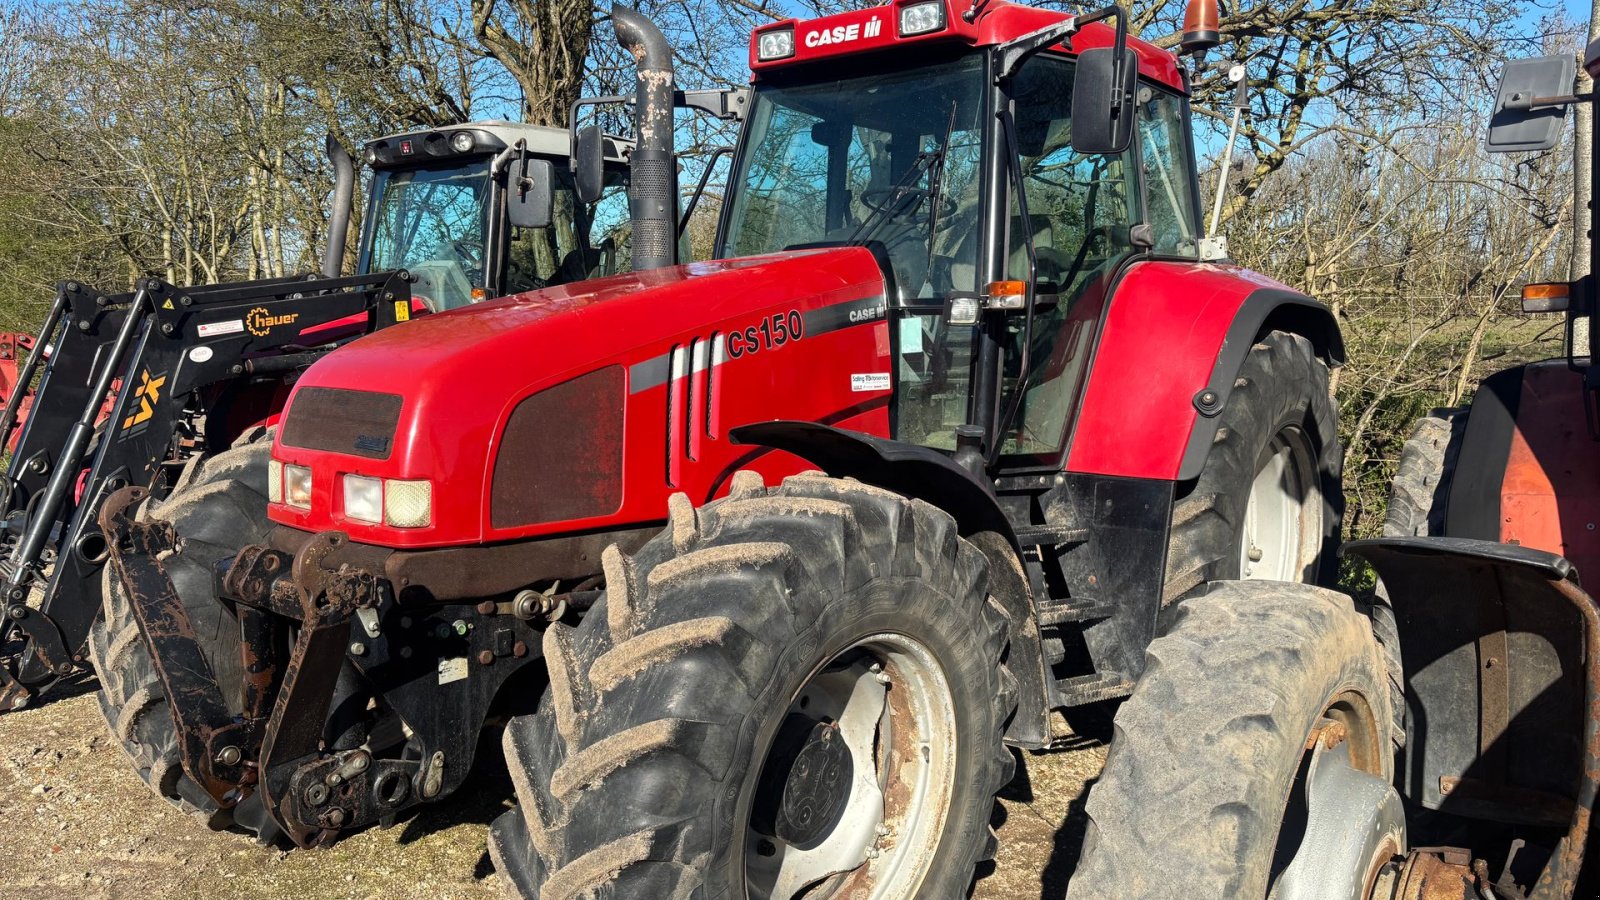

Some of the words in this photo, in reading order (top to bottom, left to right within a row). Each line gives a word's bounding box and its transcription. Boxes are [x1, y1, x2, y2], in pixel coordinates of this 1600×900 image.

[805, 23, 860, 48] CASE
[255, 313, 299, 328] hauer
[849, 308, 875, 323] CASE
[727, 308, 804, 360] CS150
